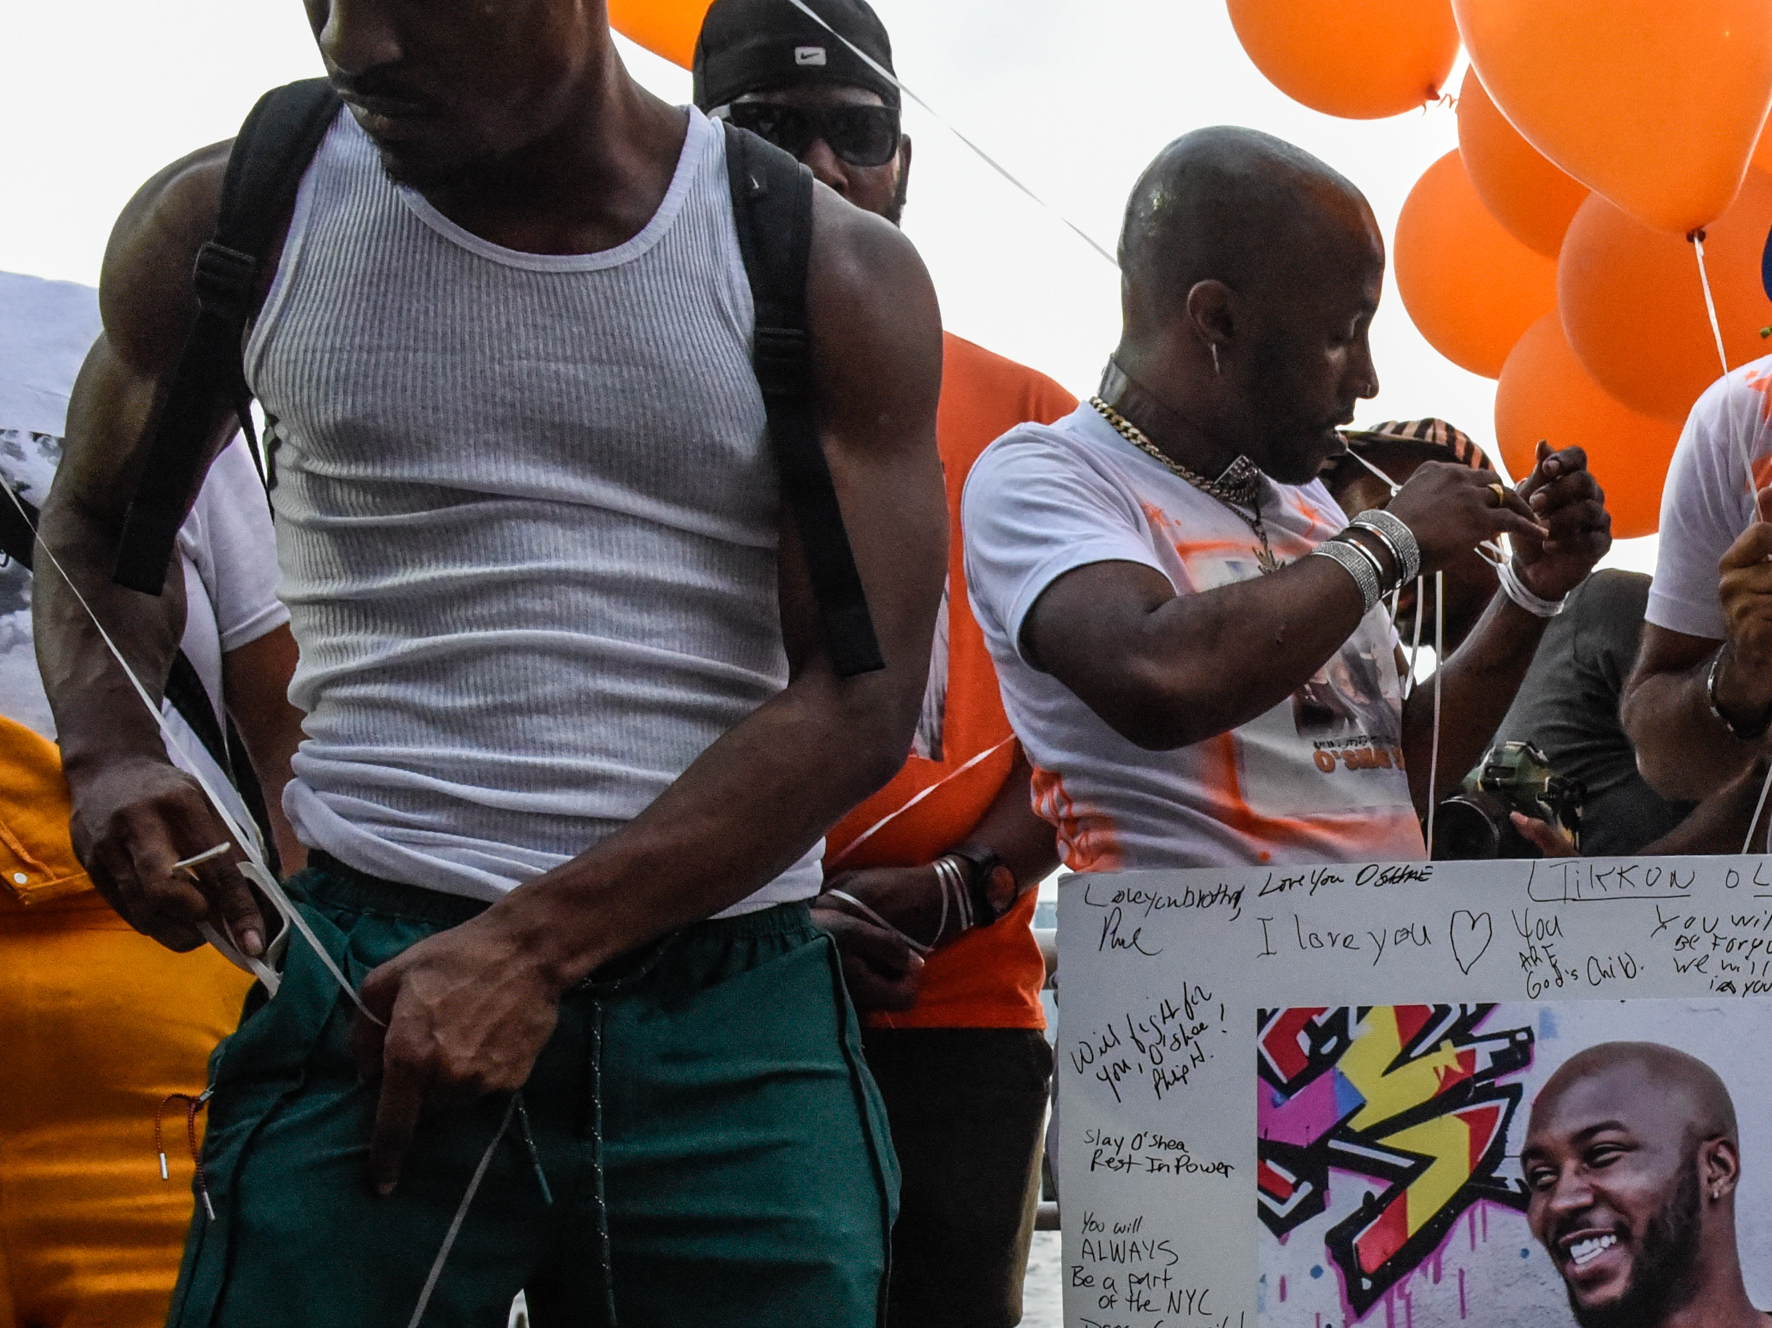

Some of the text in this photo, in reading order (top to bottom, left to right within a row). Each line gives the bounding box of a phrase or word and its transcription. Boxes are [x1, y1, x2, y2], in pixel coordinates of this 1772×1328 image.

[1257, 914, 1431, 966] I love you
[1090, 1148, 1142, 1174] Rest
[1175, 1154, 1235, 1178] Power
[1082, 1211, 1143, 1234] You will
[1082, 1238, 1179, 1266] ALWAYS
[1071, 1266, 1172, 1296] Be a part
[1125, 1291, 1160, 1312] the
[1167, 1289, 1212, 1315] NYC
